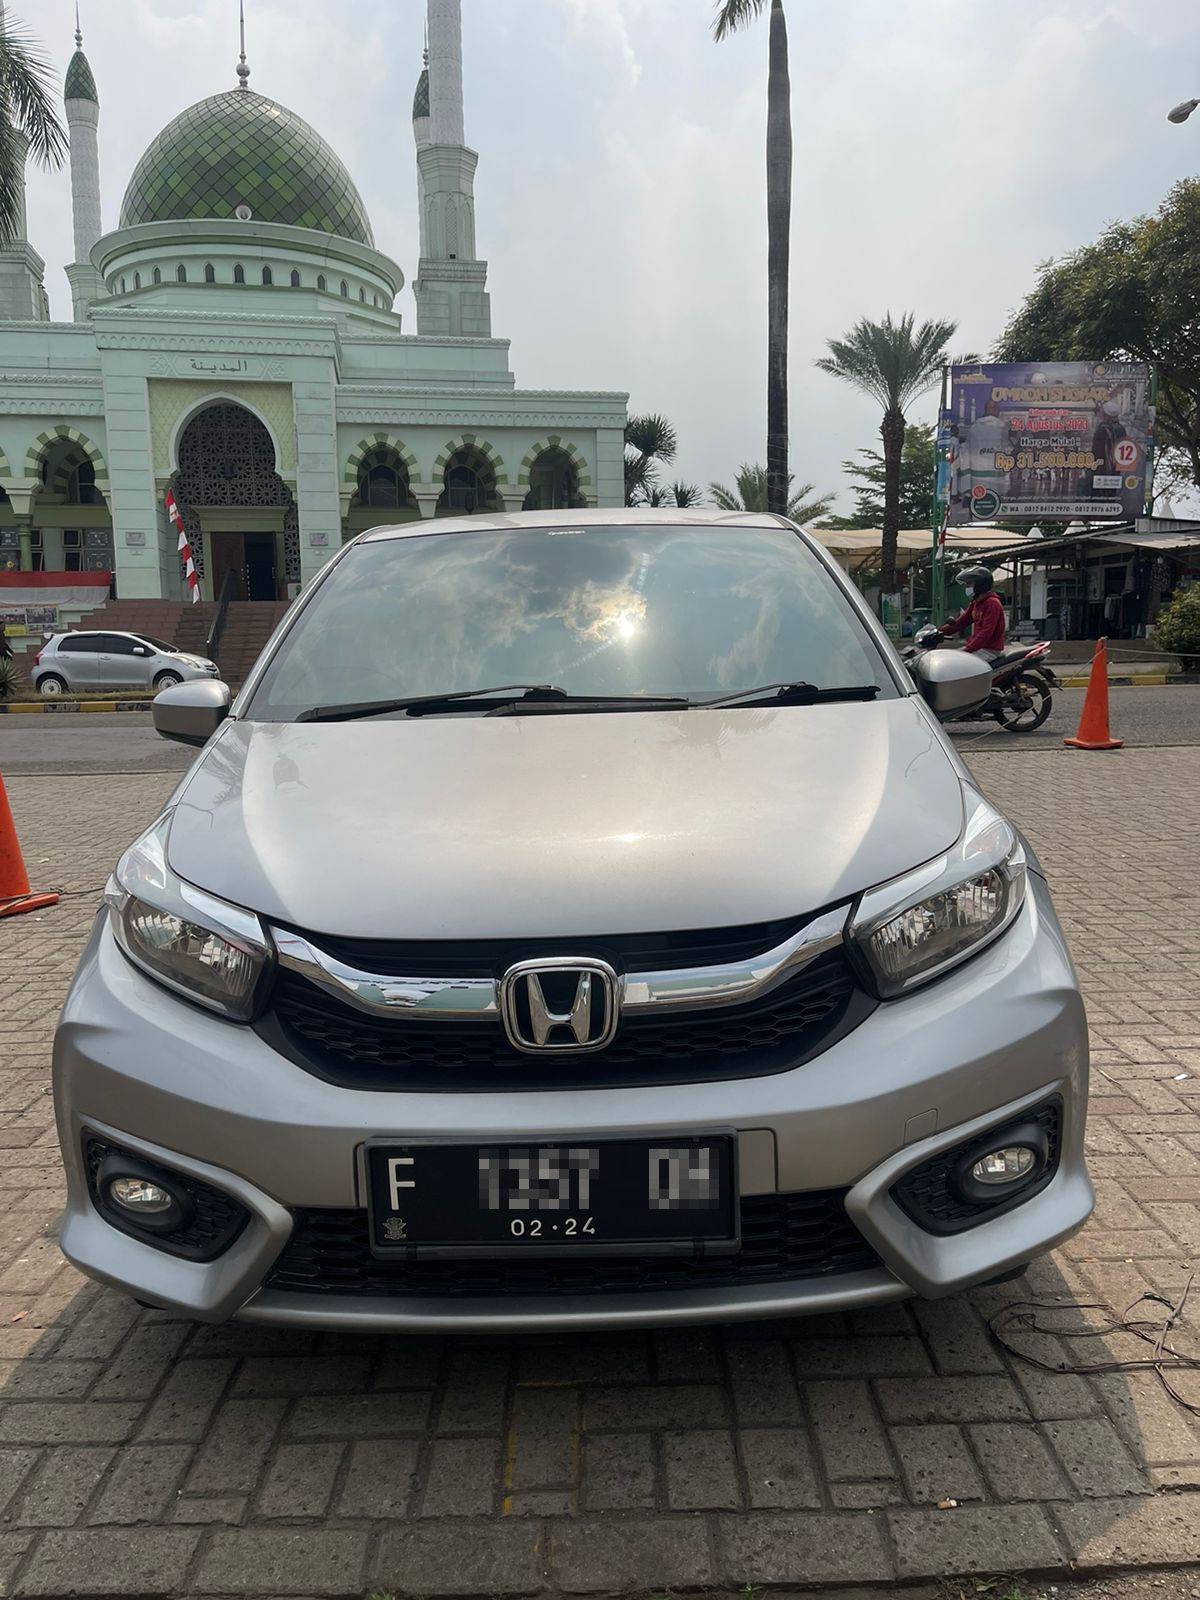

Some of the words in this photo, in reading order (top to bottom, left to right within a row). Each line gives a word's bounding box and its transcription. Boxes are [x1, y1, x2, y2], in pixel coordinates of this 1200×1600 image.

[190, 358, 247, 374] المدينة
[1066, 418, 1088, 431] 2023
[1021, 437, 1048, 448] Harga
[1118, 445, 1134, 461] 12
[995, 452, 1015, 471] Rp
[388, 1157, 415, 1210] F
